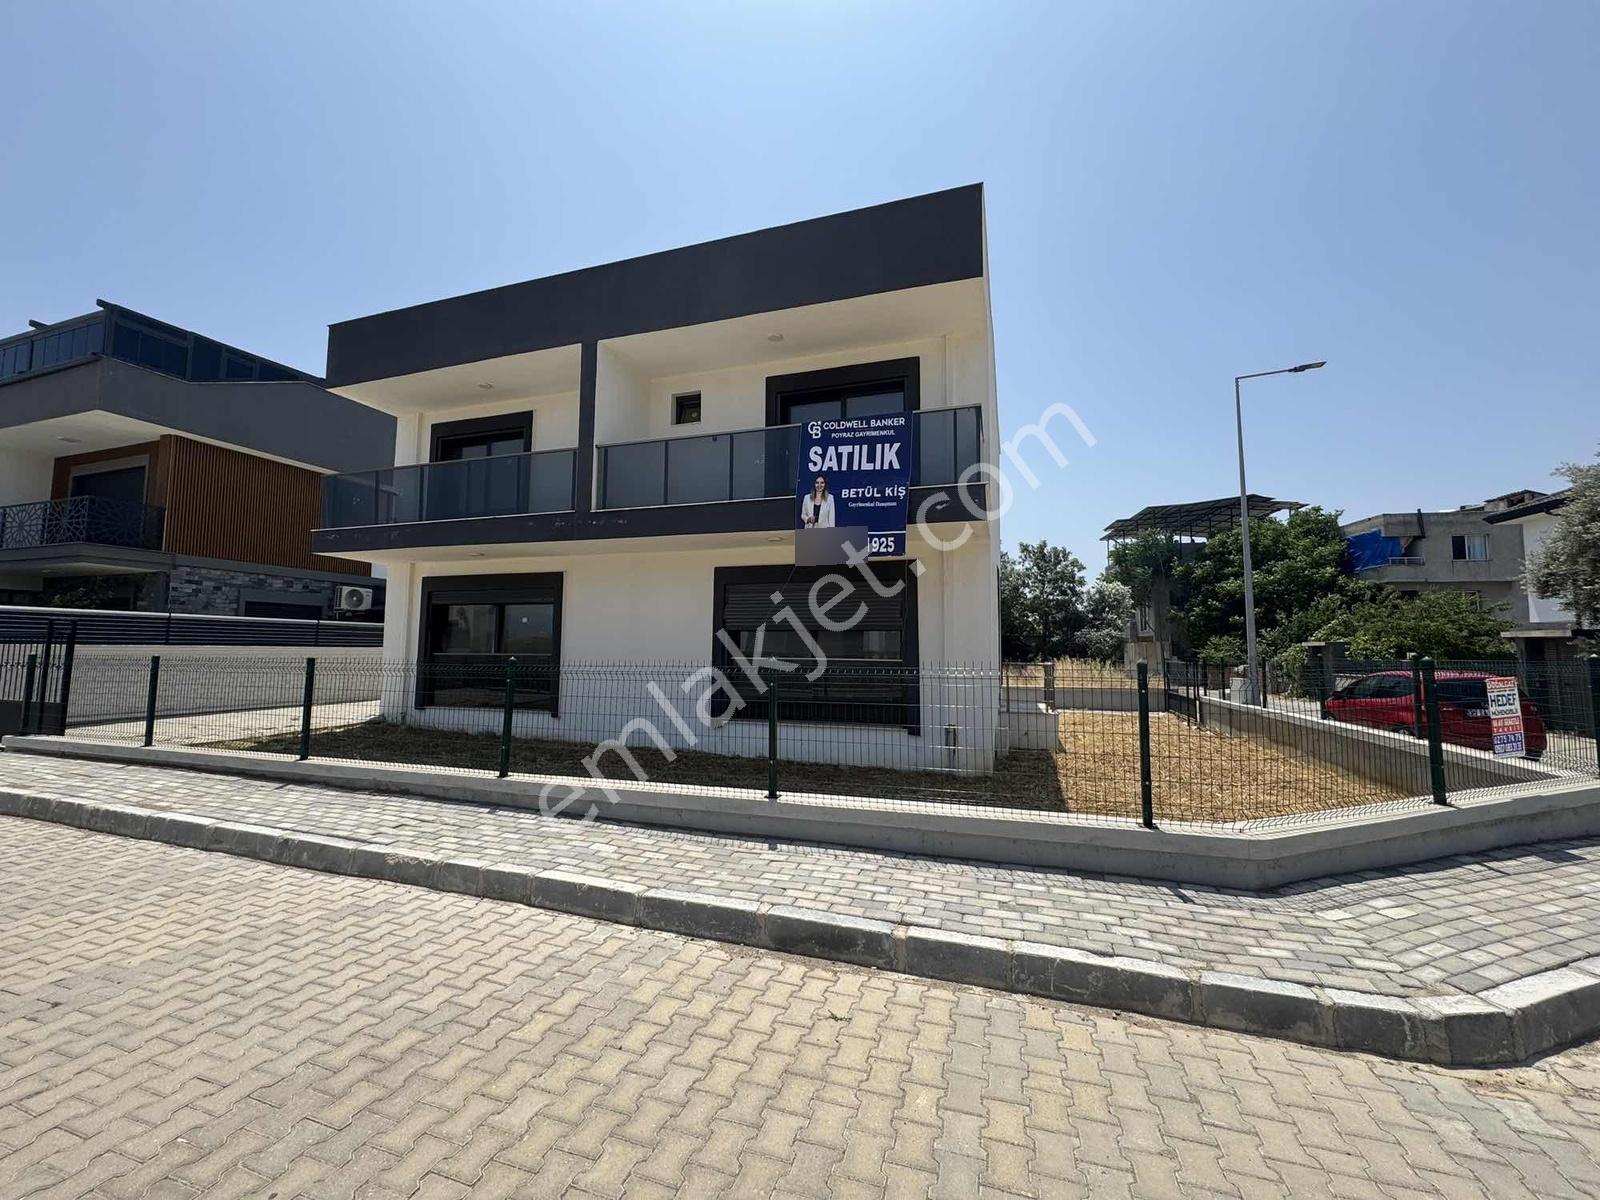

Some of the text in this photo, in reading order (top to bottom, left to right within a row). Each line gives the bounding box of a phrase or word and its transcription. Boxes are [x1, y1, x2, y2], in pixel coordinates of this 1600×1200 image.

[823, 420, 868, 430] COLDWELL
[870, 417, 905, 428] BANKER
[831, 431, 854, 439] POYRAZ
[808, 442, 901, 472] SATILIK
[841, 484, 906, 499] BETÜL KİŞ
[867, 537, 895, 553] 925
[1489, 693, 1517, 708] HEDEF
